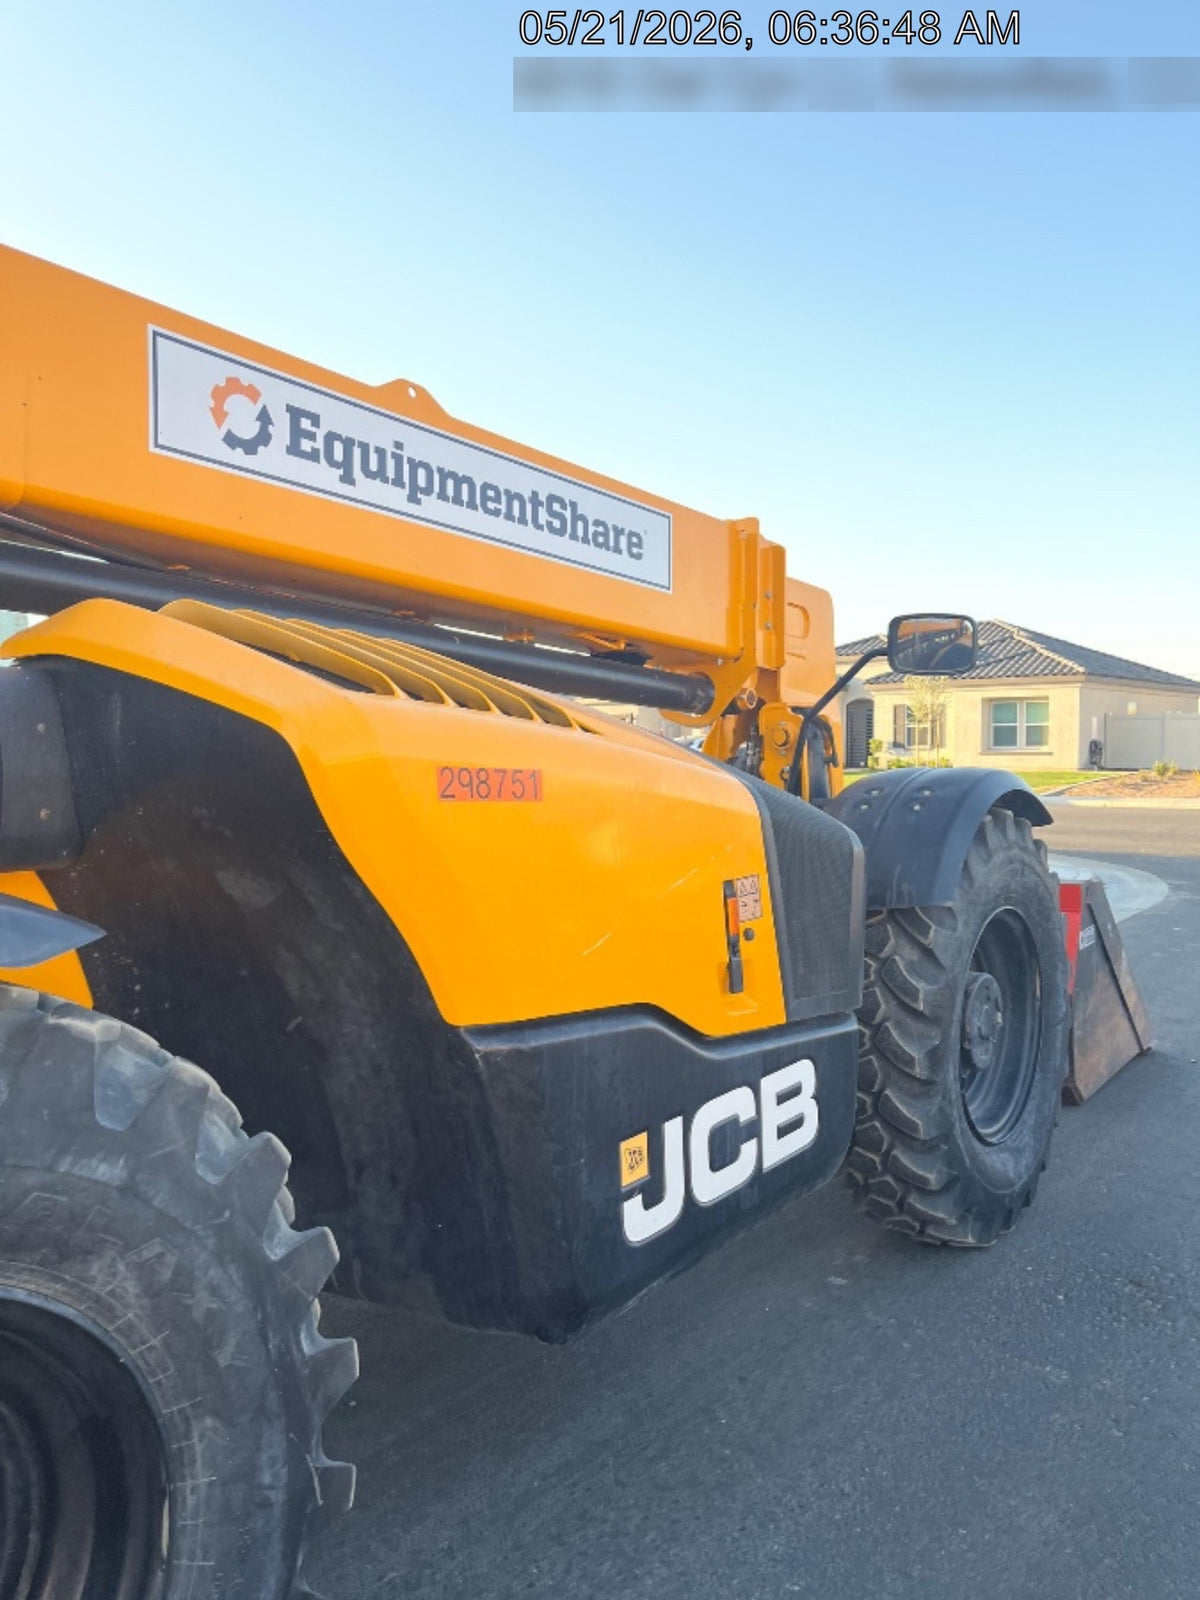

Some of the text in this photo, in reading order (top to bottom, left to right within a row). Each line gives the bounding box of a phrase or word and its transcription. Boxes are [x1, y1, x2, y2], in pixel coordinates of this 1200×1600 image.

[285, 403, 645, 561] EquipmentShare
[440, 767, 538, 799] 298751
[622, 1058, 819, 1244] JCB
